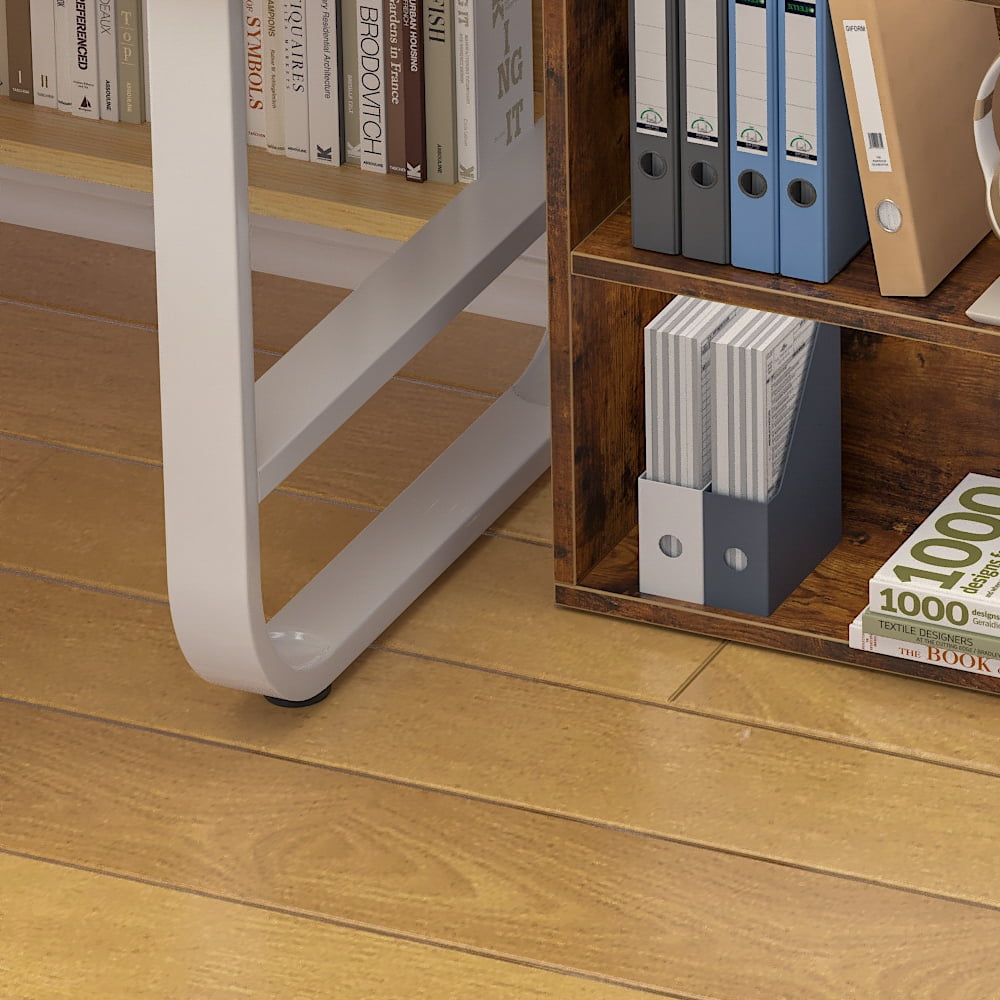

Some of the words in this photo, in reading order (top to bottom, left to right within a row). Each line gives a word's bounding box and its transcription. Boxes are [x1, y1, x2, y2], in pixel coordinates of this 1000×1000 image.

[402, 0, 410, 27] FRENCH
[457, 10, 469, 28] IT
[321, 10, 331, 54] Residential
[246, 15, 264, 110] SYMBOLS
[390, 46, 401, 59] in
[409, 31, 418, 72] HOUSING
[323, 54, 332, 100] Architecture
[359, 5, 382, 156] BRODOVITCH
[390, 61, 402, 105] France
[880, 588, 969, 626] 1000
[971, 608, 1000, 622] designs
[878, 619, 917, 636] TEXTILE
[919, 628, 974, 647] DESIGNERS
[935, 639, 958, 649] CUTTING
[898, 647, 922, 659] THE
[927, 645, 992, 673] BOOK
